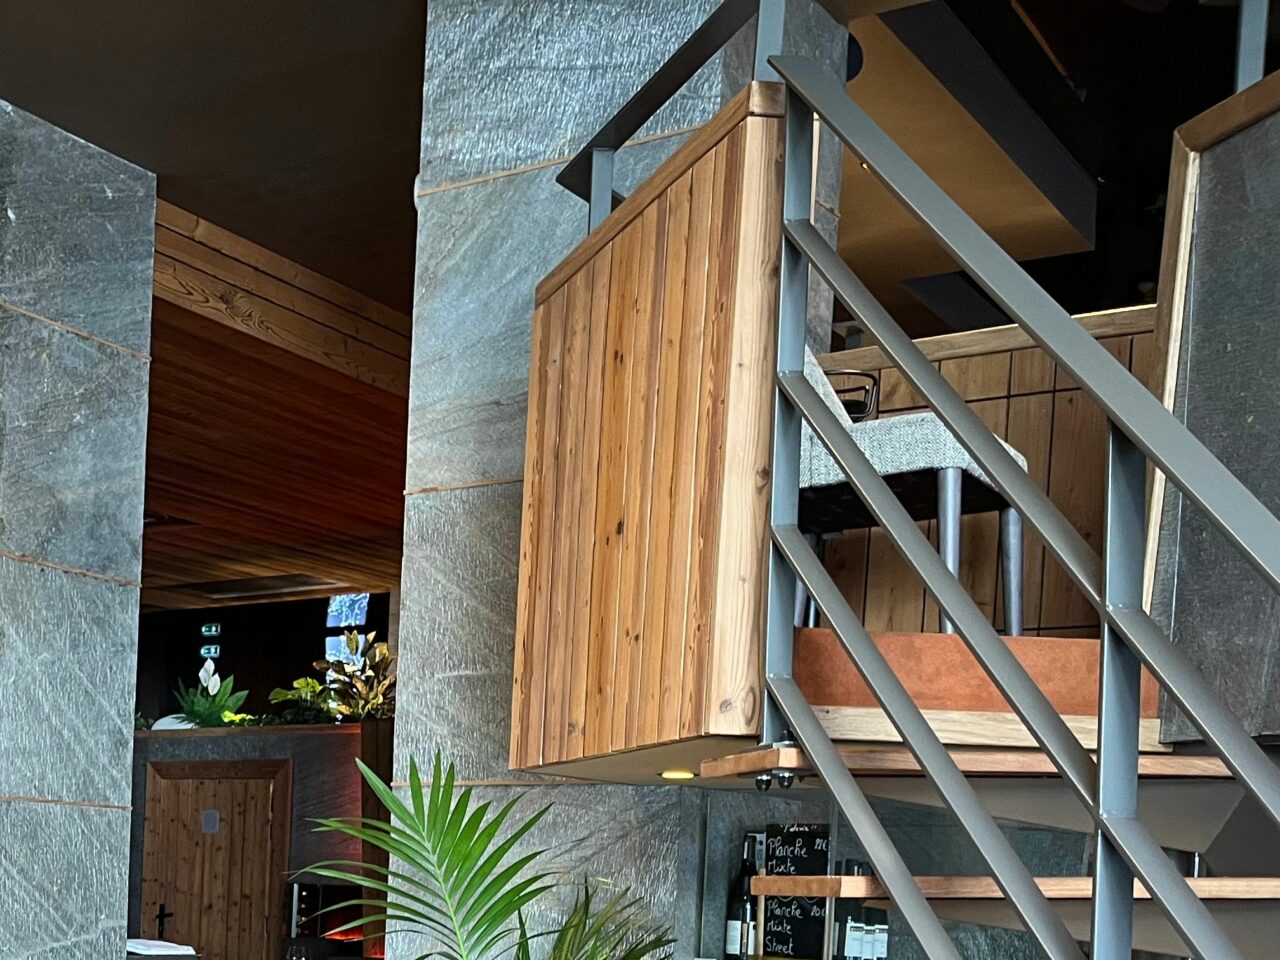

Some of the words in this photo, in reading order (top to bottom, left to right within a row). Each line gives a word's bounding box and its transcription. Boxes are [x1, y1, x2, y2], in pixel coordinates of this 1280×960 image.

[767, 836, 808, 857] Planche
[768, 858, 796, 874] Mixte
[766, 899, 804, 918] Planche
[765, 936, 794, 955] Street
